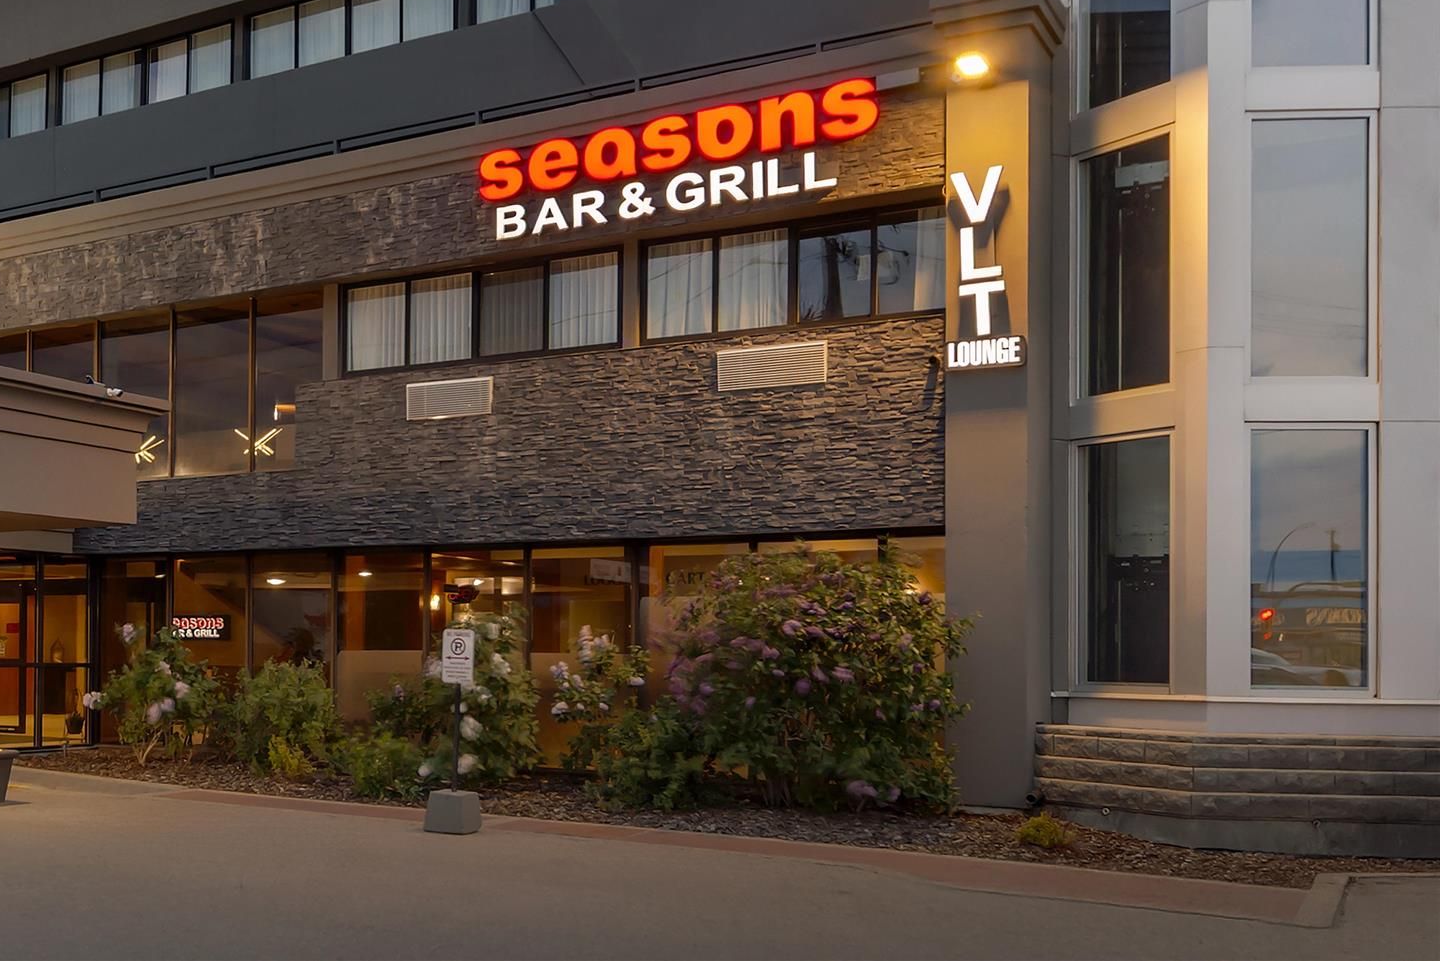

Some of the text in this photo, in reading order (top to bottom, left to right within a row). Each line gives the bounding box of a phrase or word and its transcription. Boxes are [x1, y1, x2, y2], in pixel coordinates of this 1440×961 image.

[478, 77, 880, 202] seasons
[495, 152, 838, 241] BAR & GRILL
[950, 165, 1006, 337] VLT
[947, 337, 1021, 368] LOUNGE
[172, 617, 225, 629] easons
[193, 629, 220, 638] GRILL
